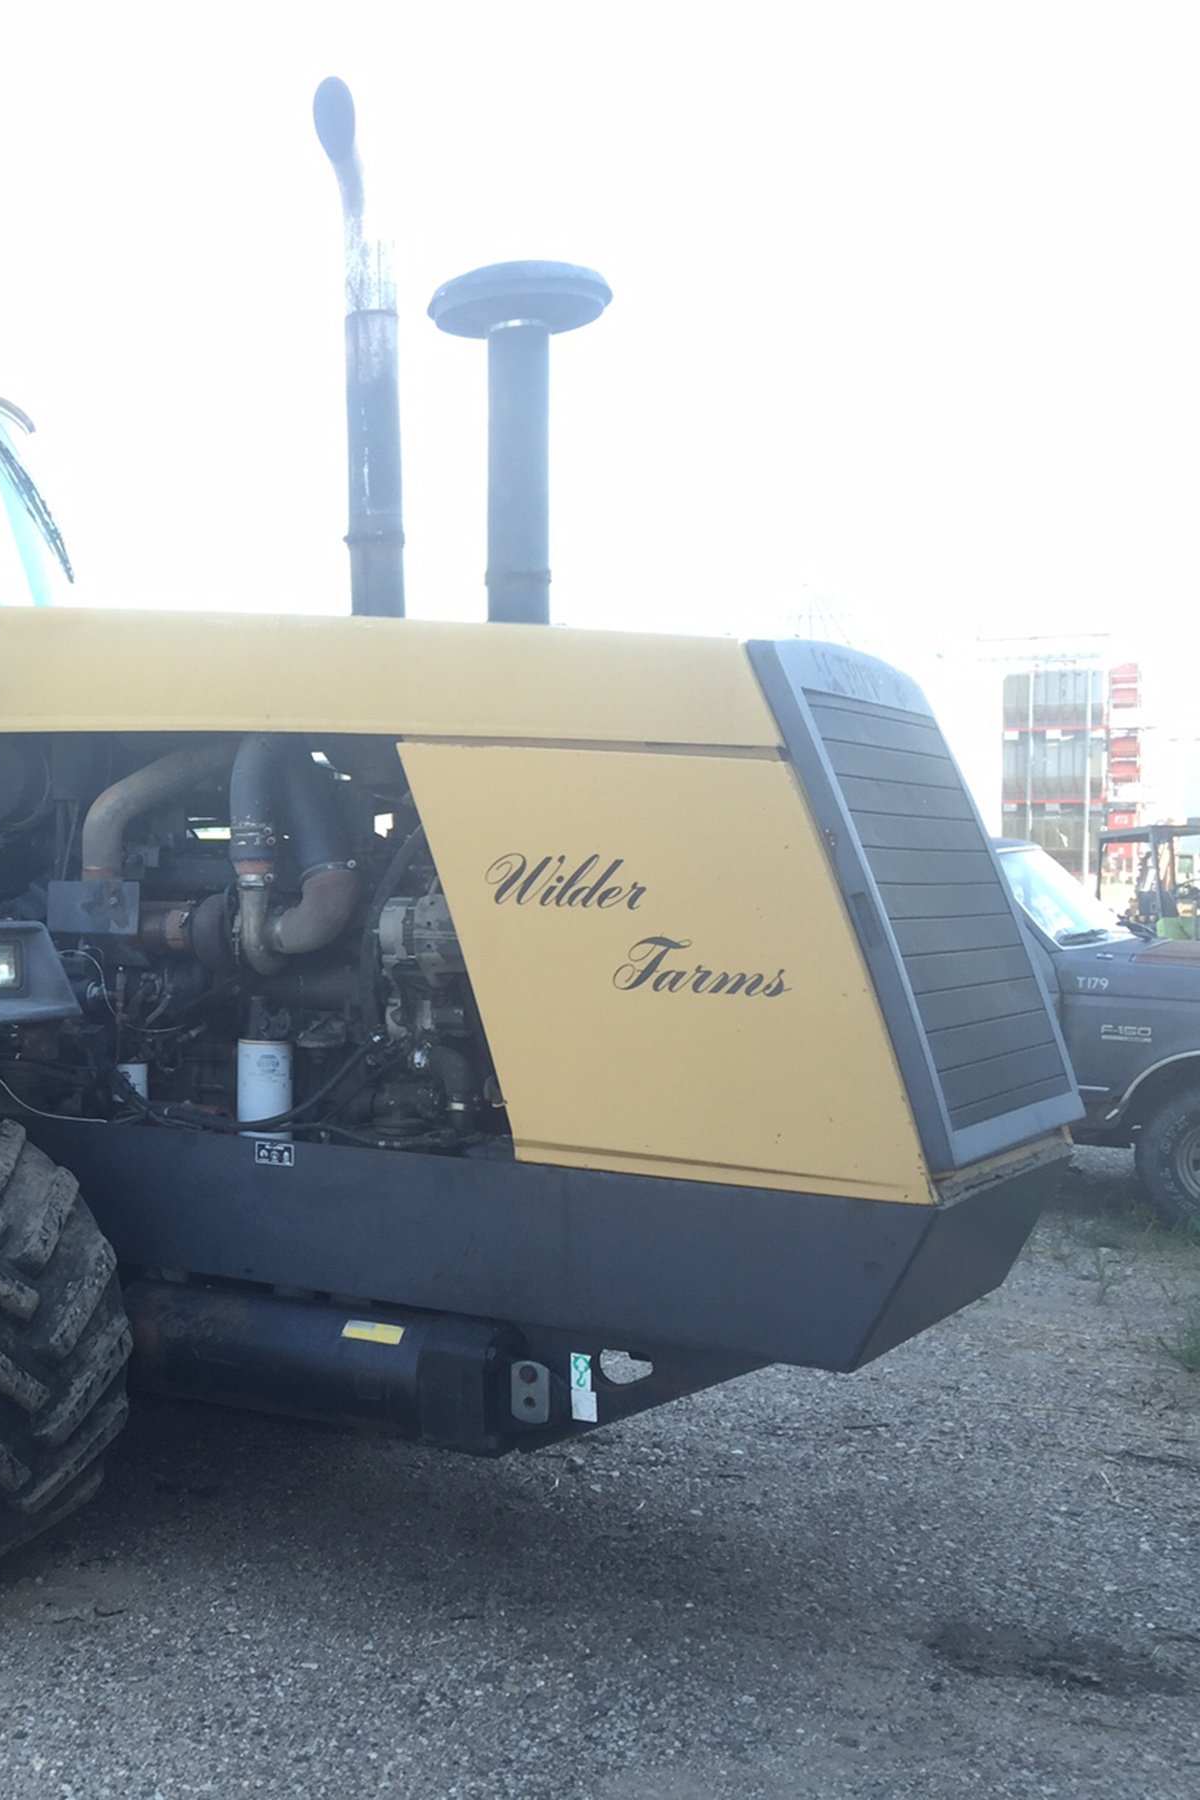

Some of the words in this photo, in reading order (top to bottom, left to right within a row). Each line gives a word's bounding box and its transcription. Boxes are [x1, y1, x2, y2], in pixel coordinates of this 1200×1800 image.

[485, 852, 647, 910] Wilder
[612, 933, 792, 997] Farms
[1101, 1024, 1152, 1037] F-150
